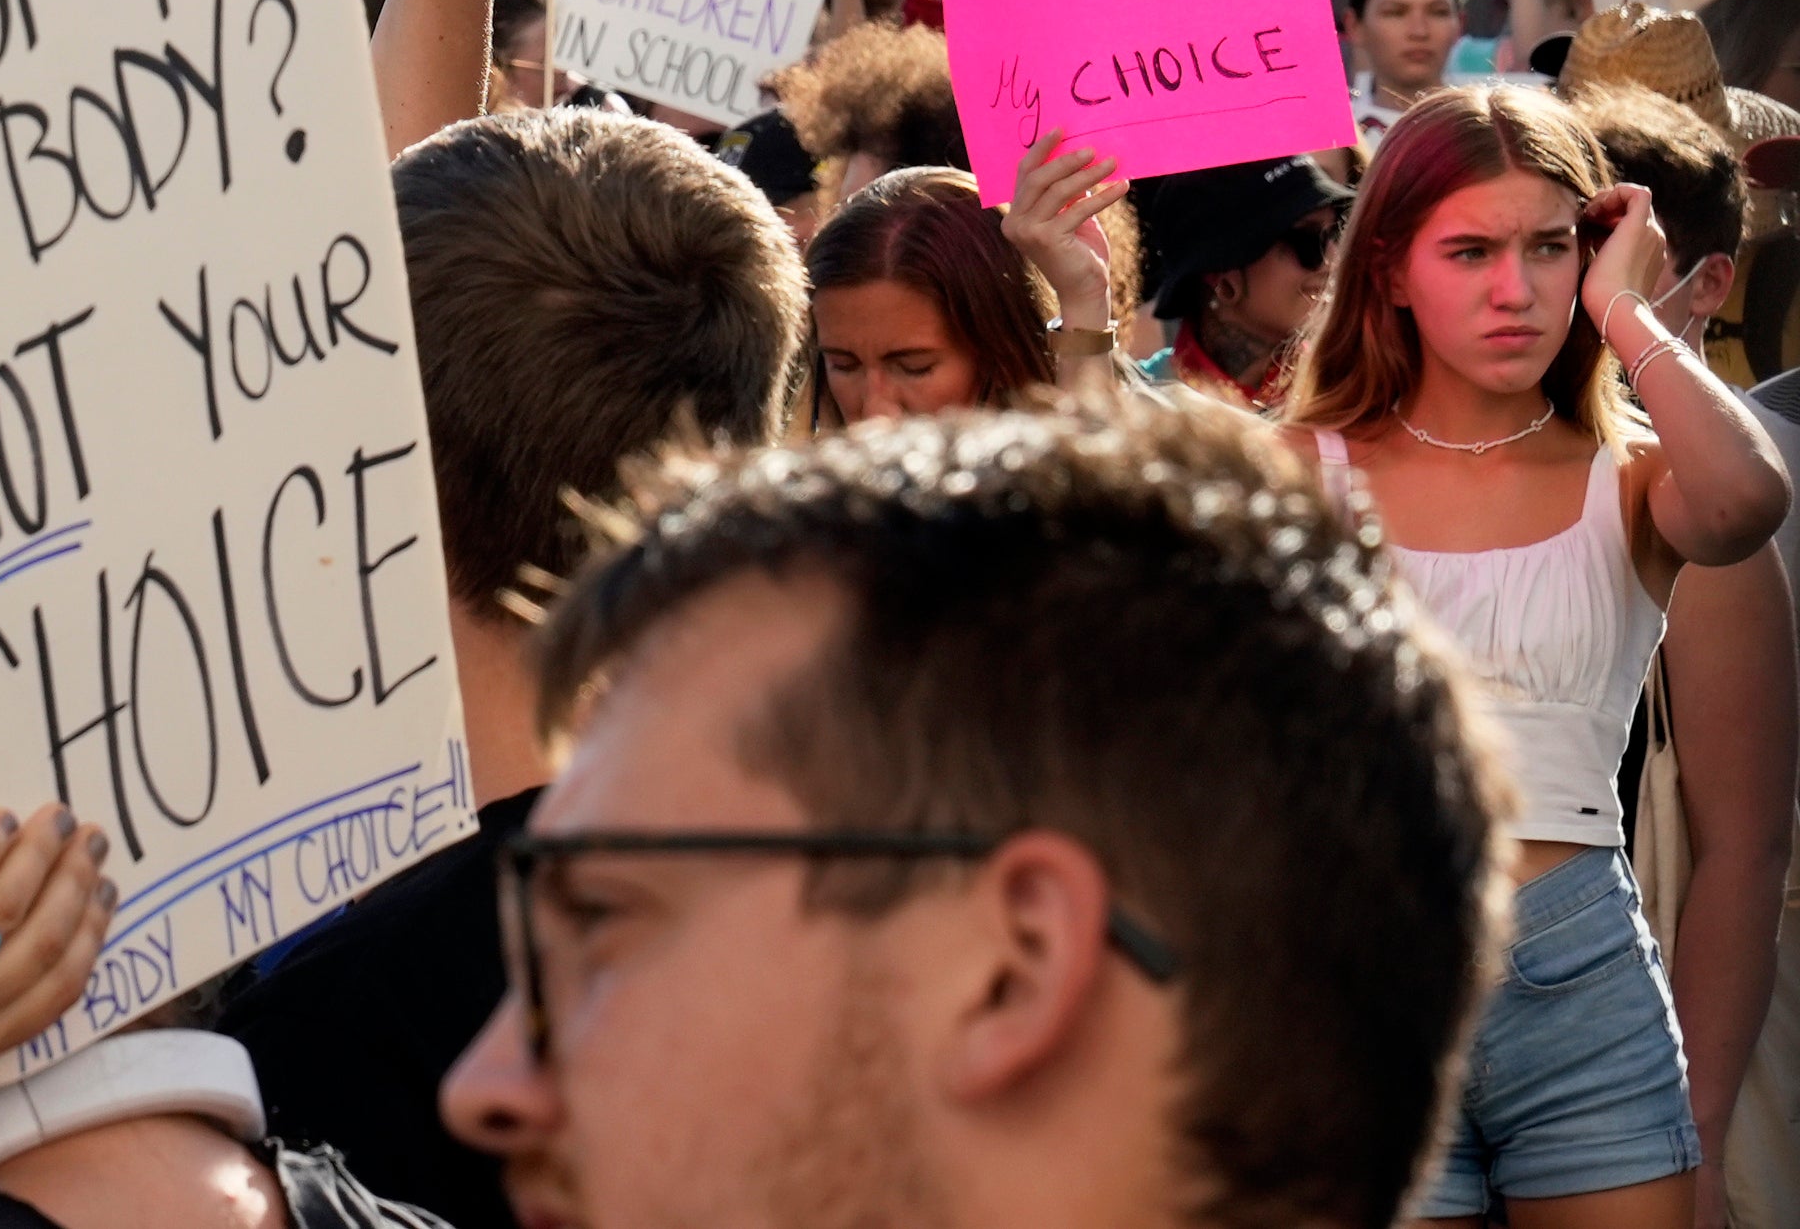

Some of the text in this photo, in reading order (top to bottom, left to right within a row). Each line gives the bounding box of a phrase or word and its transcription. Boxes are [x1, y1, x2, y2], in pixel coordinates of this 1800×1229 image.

[555, 13, 609, 70] IN
[990, 25, 1299, 149] My CHOICE
[158, 233, 400, 441] YOUR
[84, 913, 176, 1030] BODY
[219, 849, 278, 956] MY
